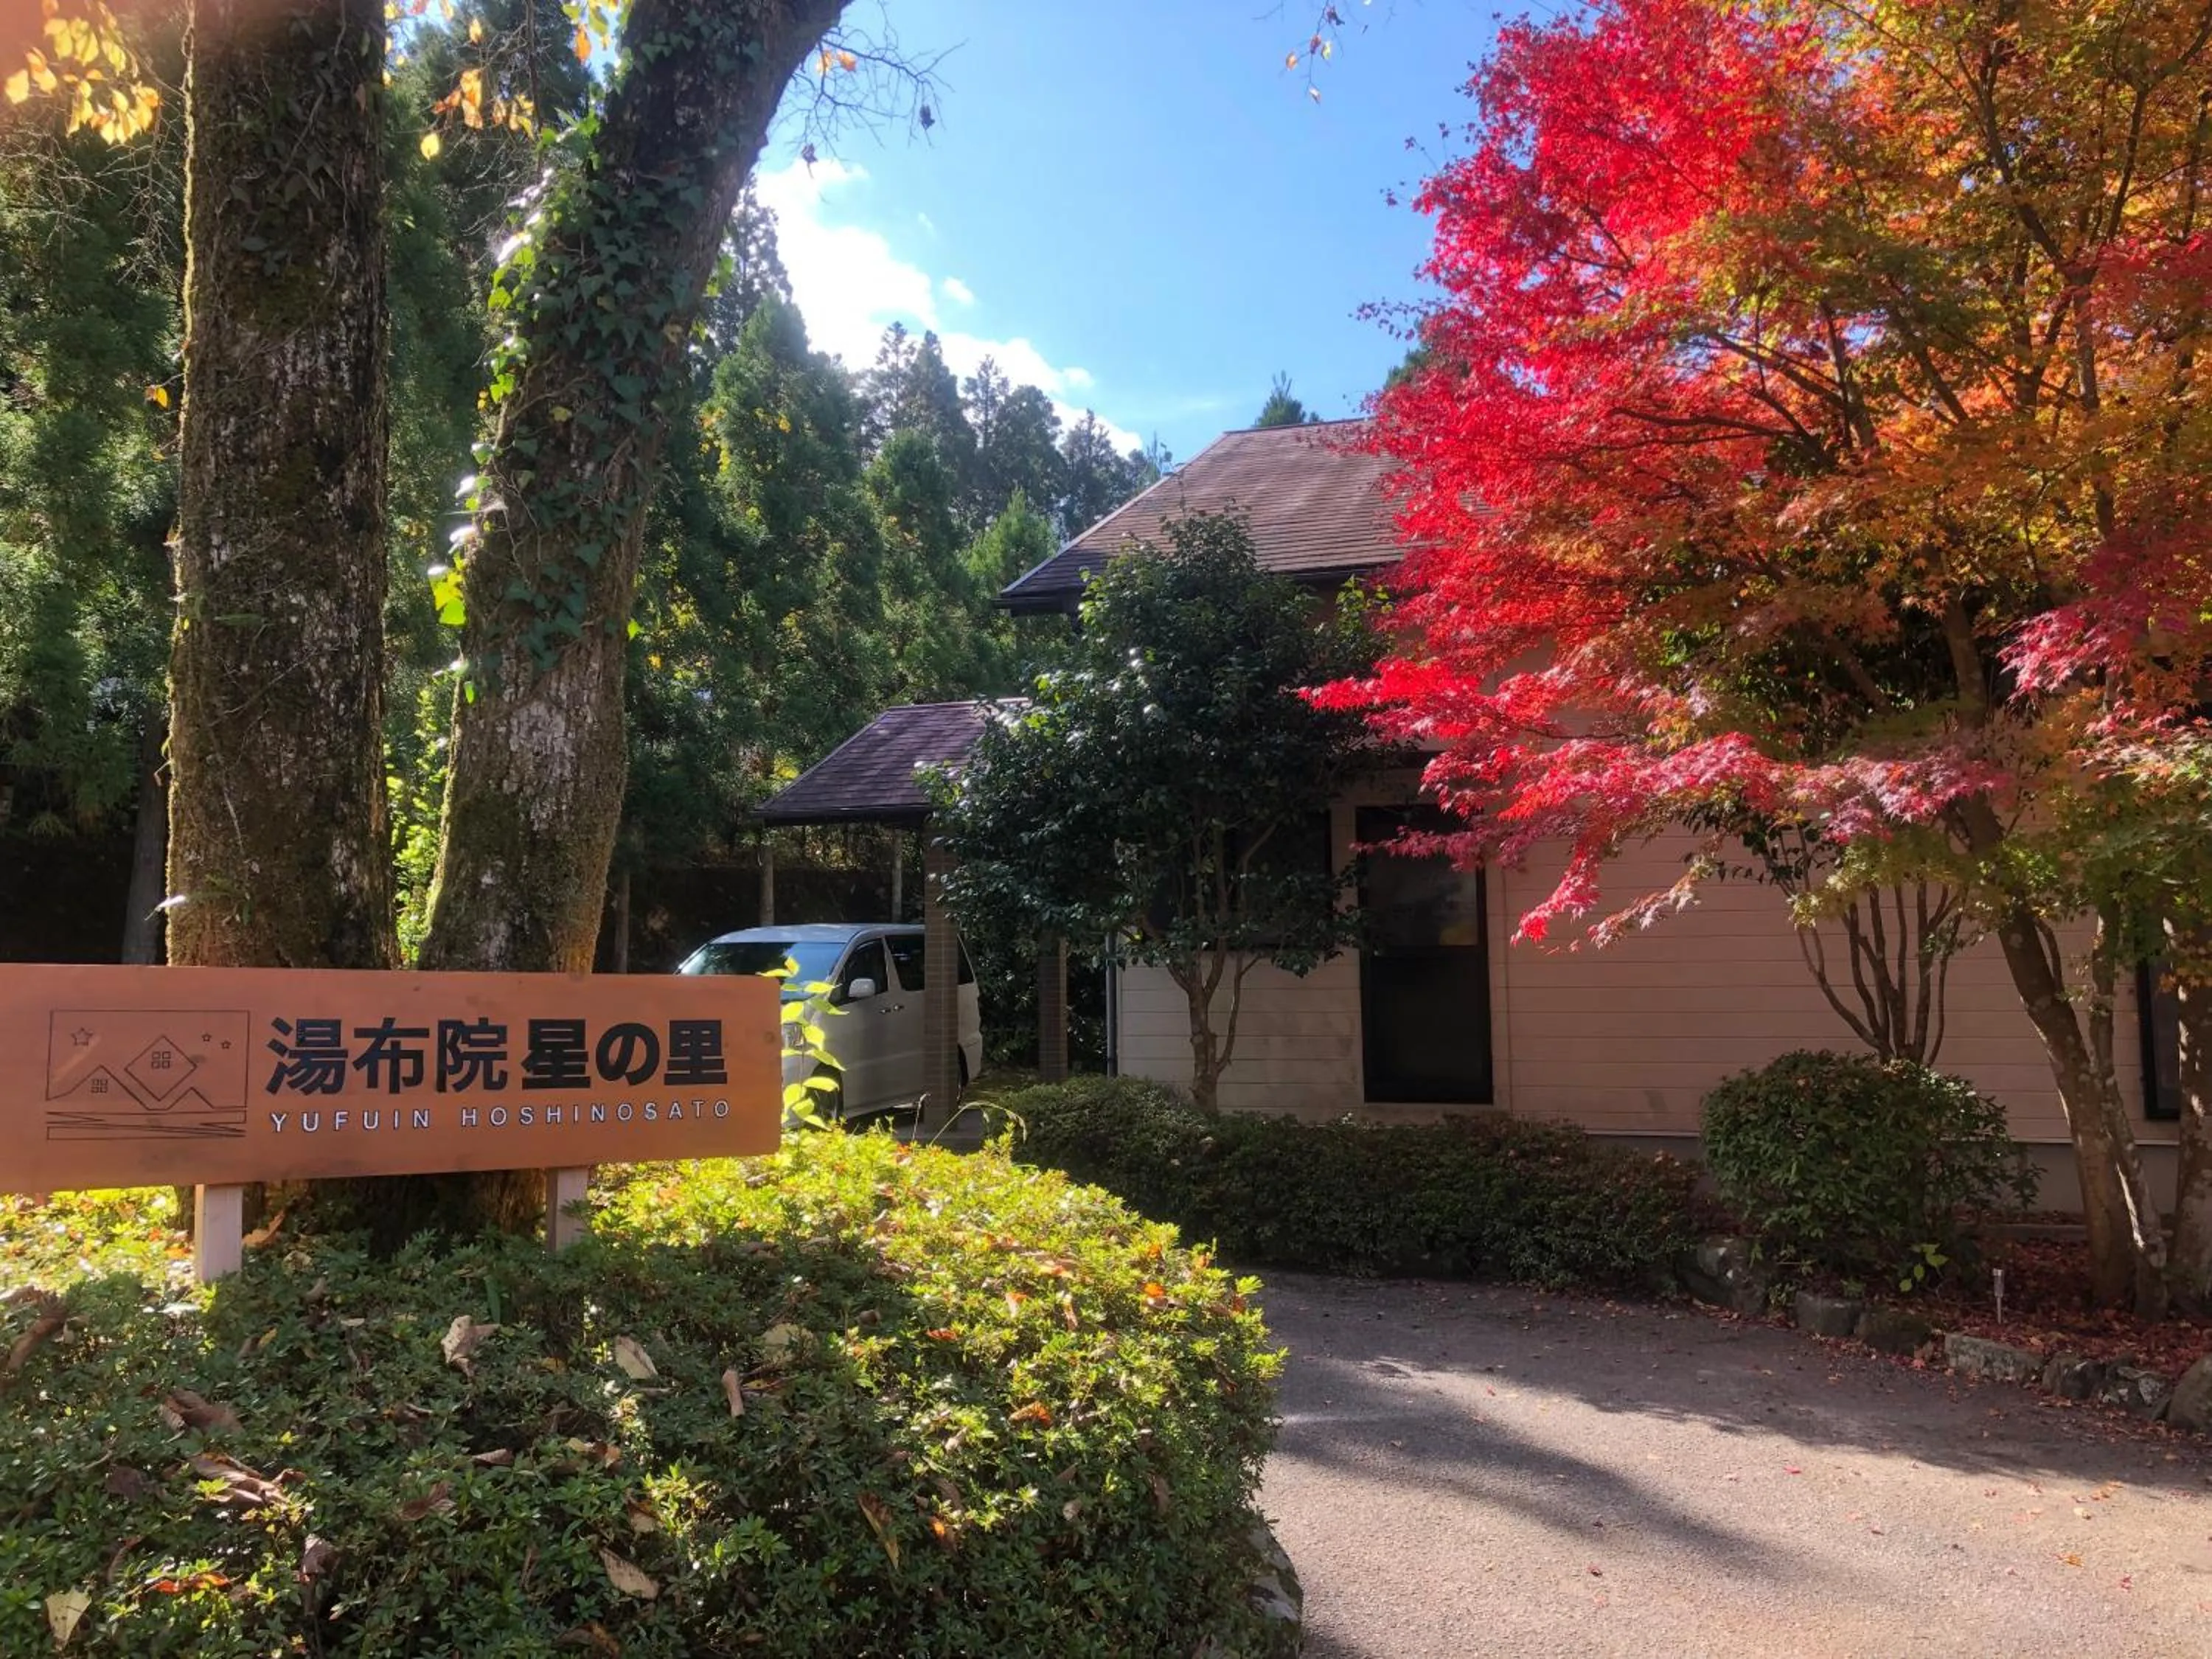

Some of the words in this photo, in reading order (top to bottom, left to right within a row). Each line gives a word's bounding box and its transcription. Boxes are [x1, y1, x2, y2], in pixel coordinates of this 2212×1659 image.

[266, 1017, 728, 1095] 湯布院星の里
[271, 1108, 430, 1133] YUFUIN
[462, 1099, 731, 1127] HOSHINOSATO
